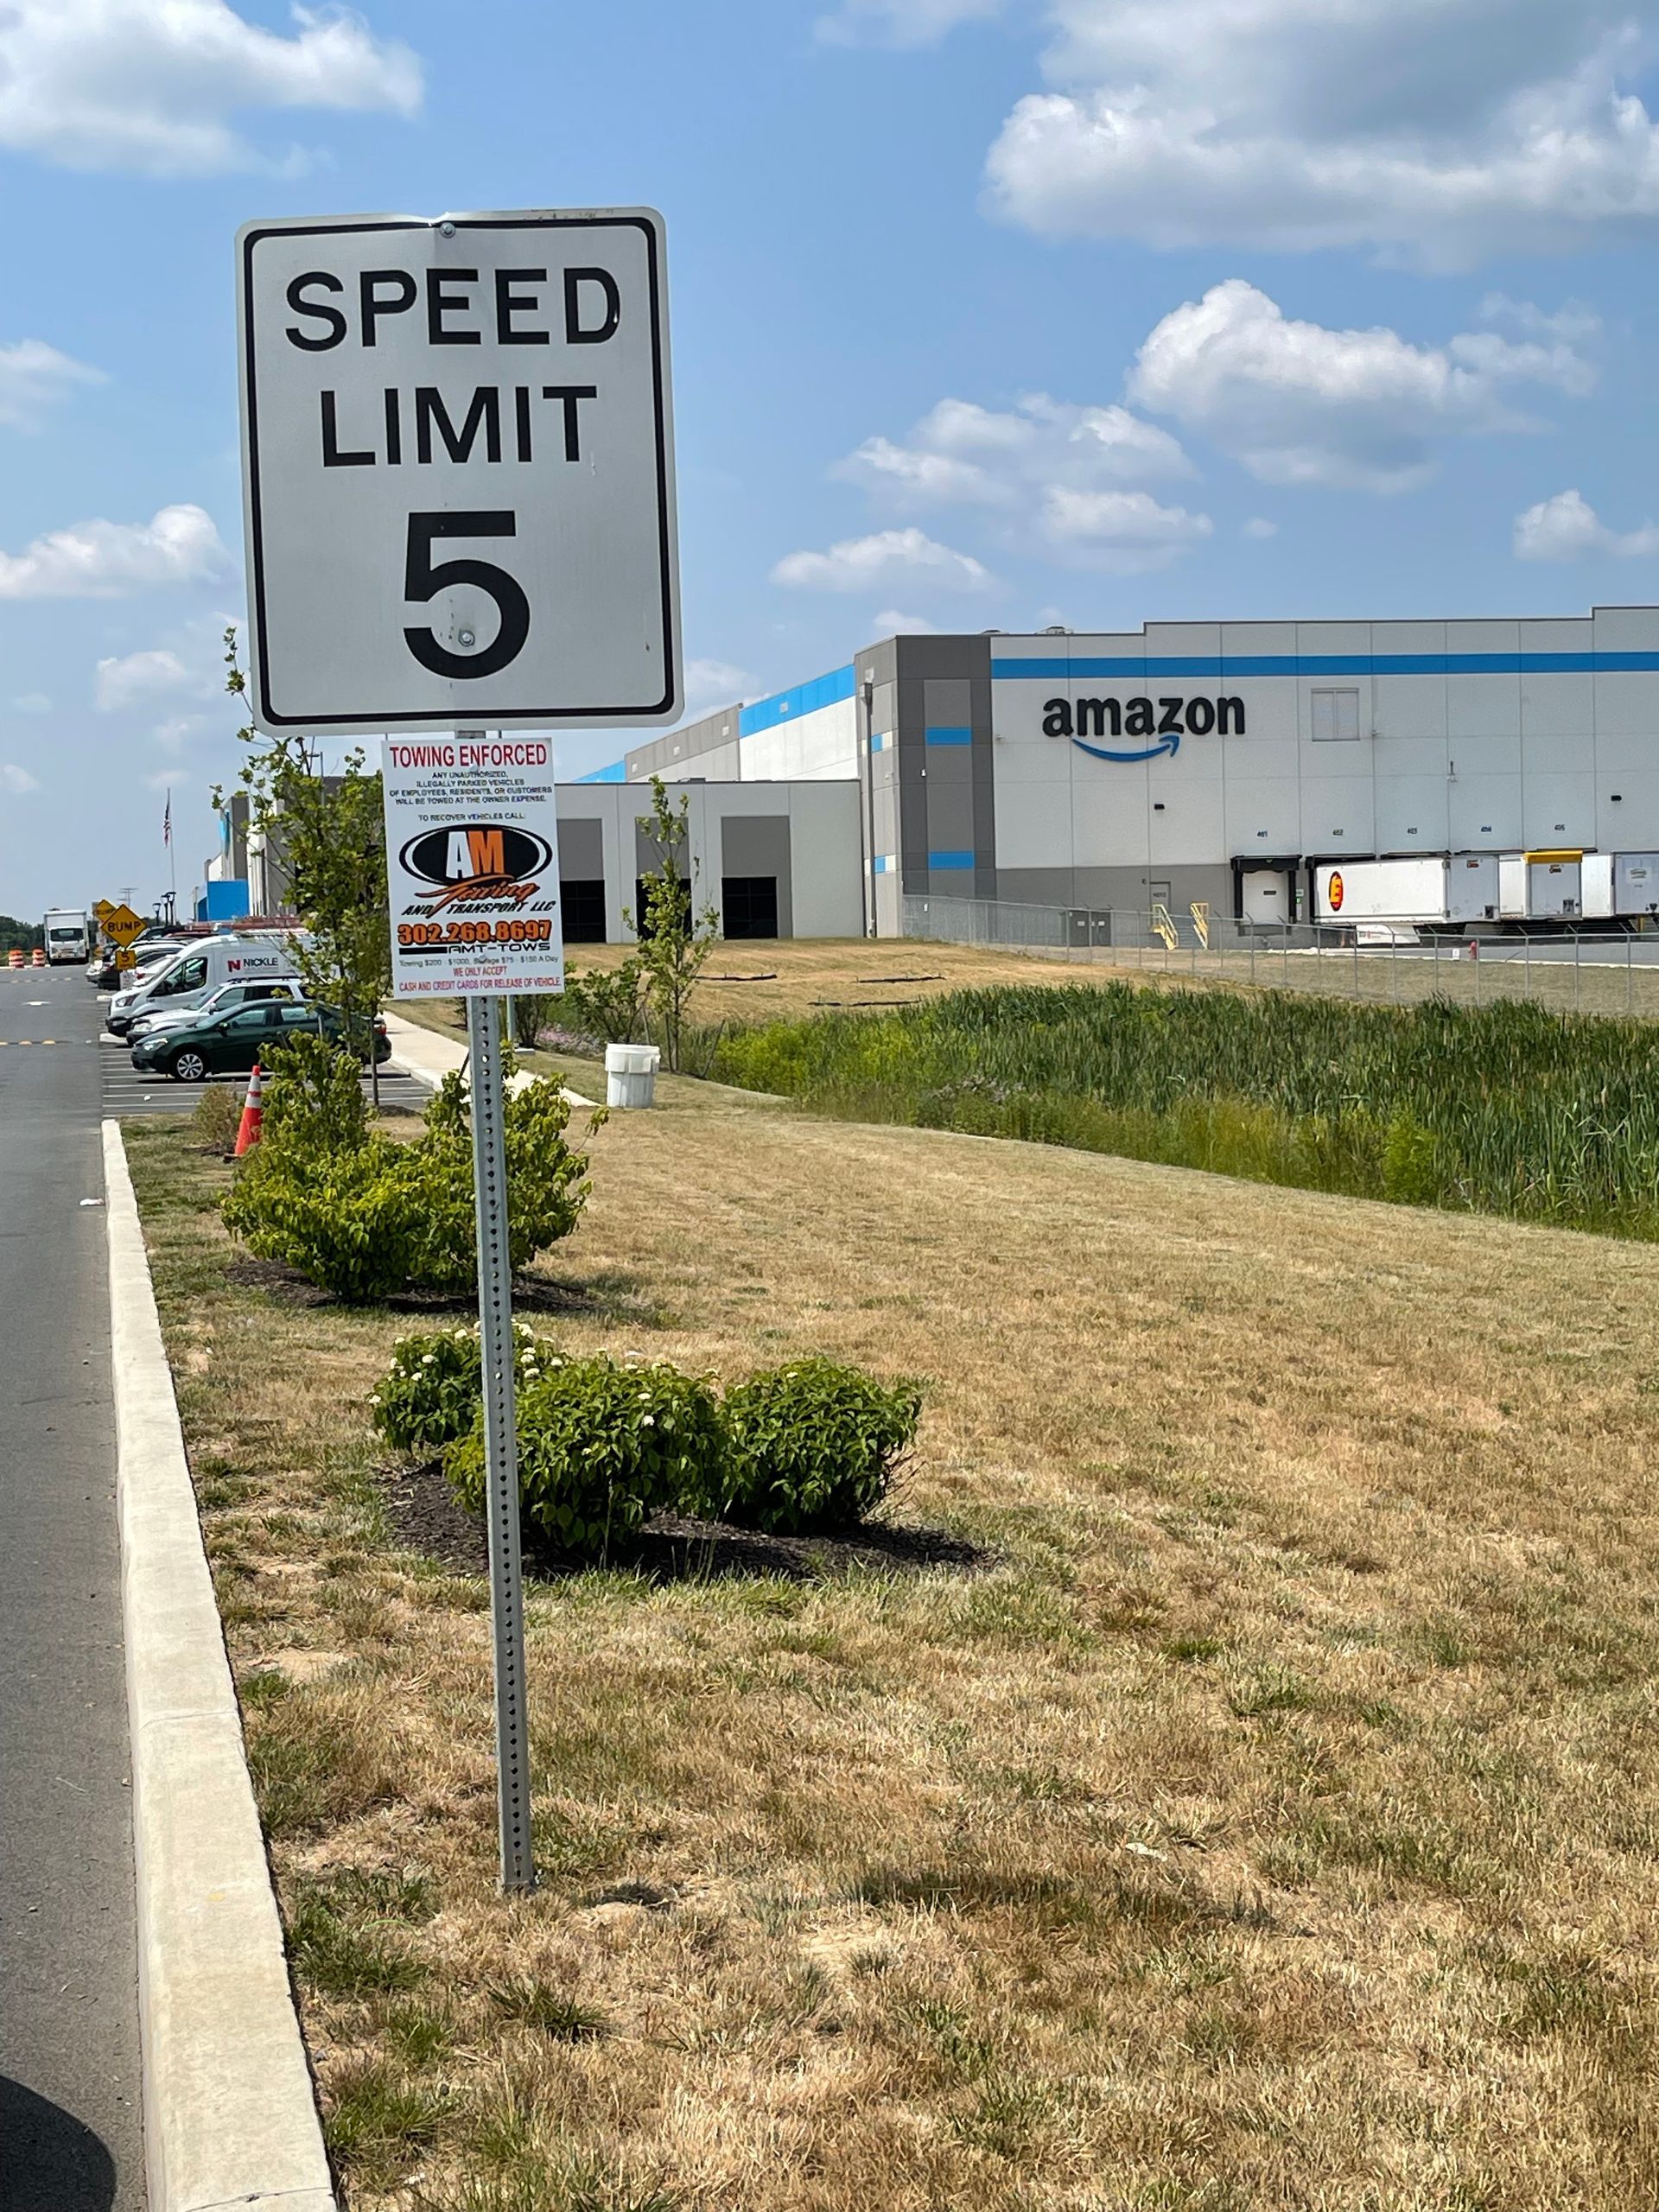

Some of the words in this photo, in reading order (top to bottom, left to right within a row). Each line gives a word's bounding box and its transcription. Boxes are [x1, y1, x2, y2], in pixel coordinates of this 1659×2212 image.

[285, 267, 620, 353] SPEED
[321, 385, 597, 467] LIMIT
[404, 510, 531, 679] 5
[1042, 697, 1245, 737] amazon
[389, 746, 454, 768] TOWING
[460, 744, 547, 767] ENFORCED
[401, 788, 448, 797] EMPLOYEES,
[506, 785, 552, 794] CUSTOMERS
[446, 830, 505, 879] AM
[415, 874, 541, 918] Towing
[401, 905, 435, 916] AND
[446, 901, 528, 915] TRANSPORT
[530, 900, 556, 912] LLC
[107, 921, 142, 933] BUMP
[397, 919, 552, 945] 302.268.8697
[448, 942, 550, 954] AMT-TOWS
[121, 951, 130, 963] 5
[243, 957, 278, 968] NICKLE
[399, 959, 423, 968] Towing
[545, 955, 558, 963] Day
[453, 968, 463, 976] WE
[465, 967, 480, 976] ONLY
[483, 965, 507, 976] ACCEPT
[399, 982, 416, 992] CASH
[418, 981, 431, 991] AND
[433, 980, 454, 991] CREDIT
[457, 979, 479, 989] CARDS
[480, 979, 493, 988] FOR
[494, 978, 523, 988] RELEASE
[524, 977, 532, 988] OF
